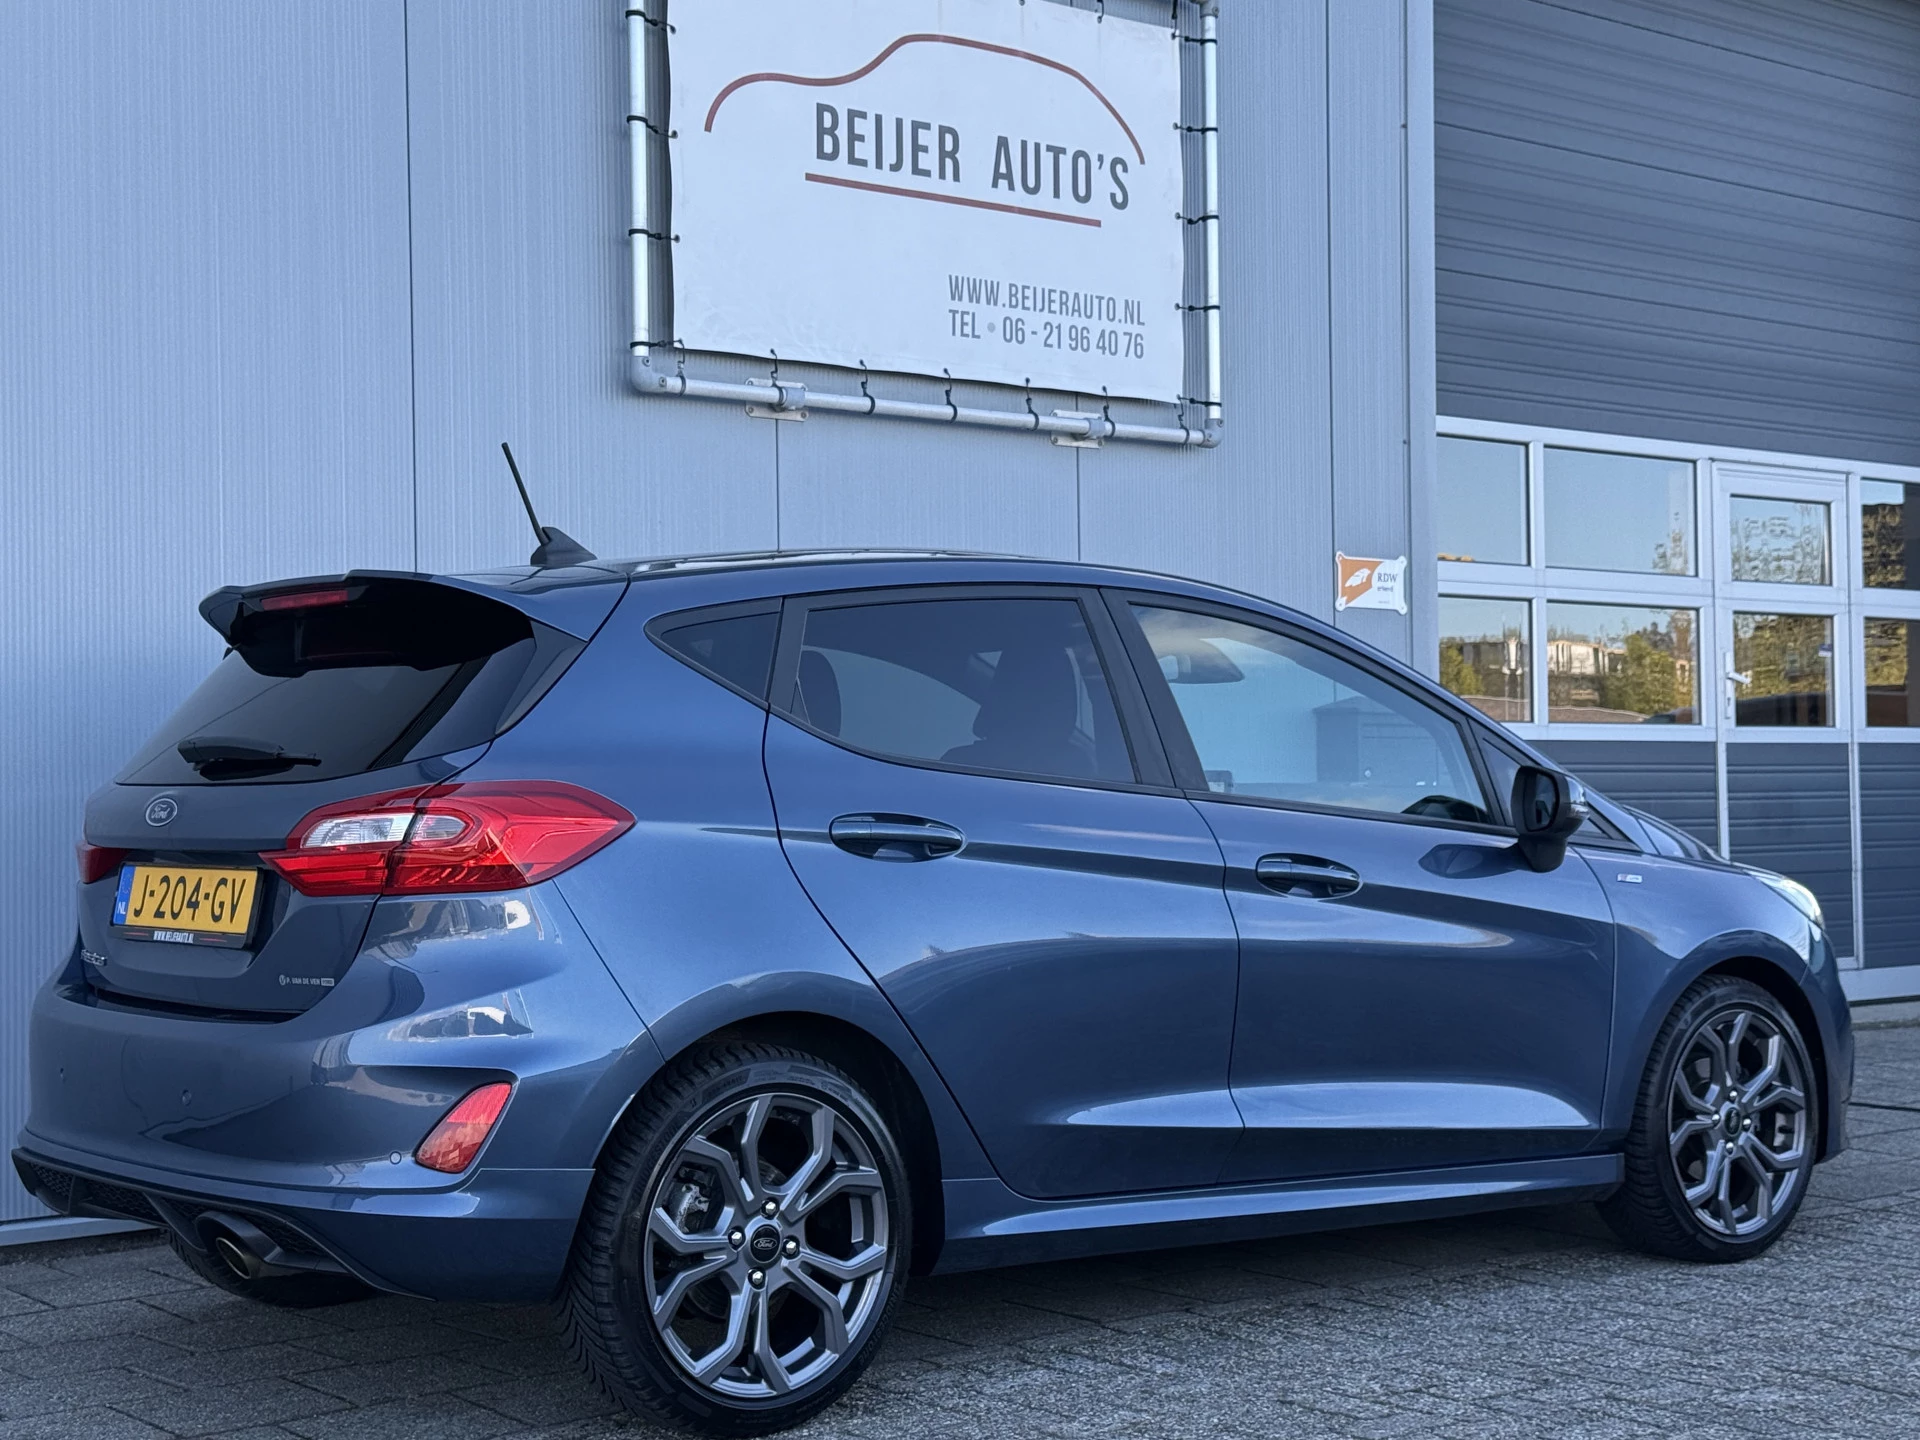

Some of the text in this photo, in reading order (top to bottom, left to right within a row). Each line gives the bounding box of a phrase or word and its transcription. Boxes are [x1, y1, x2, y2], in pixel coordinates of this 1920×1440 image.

[816, 102, 1129, 211] BEIJER AUTO'S
[948, 274, 1146, 326] WWW.BEIJERAUTO.NL
[948, 309, 981, 339] TEL
[1002, 316, 1026, 345] 06
[1043, 321, 1062, 349] 21
[1068, 325, 1090, 353] 96
[1096, 329, 1118, 356] 40
[1123, 331, 1144, 360] 76
[1377, 573, 1398, 583] RDW
[117, 901, 126, 915] NL
[133, 875, 247, 924] J-204-GV
[758, 1239, 774, 1248] Ford
